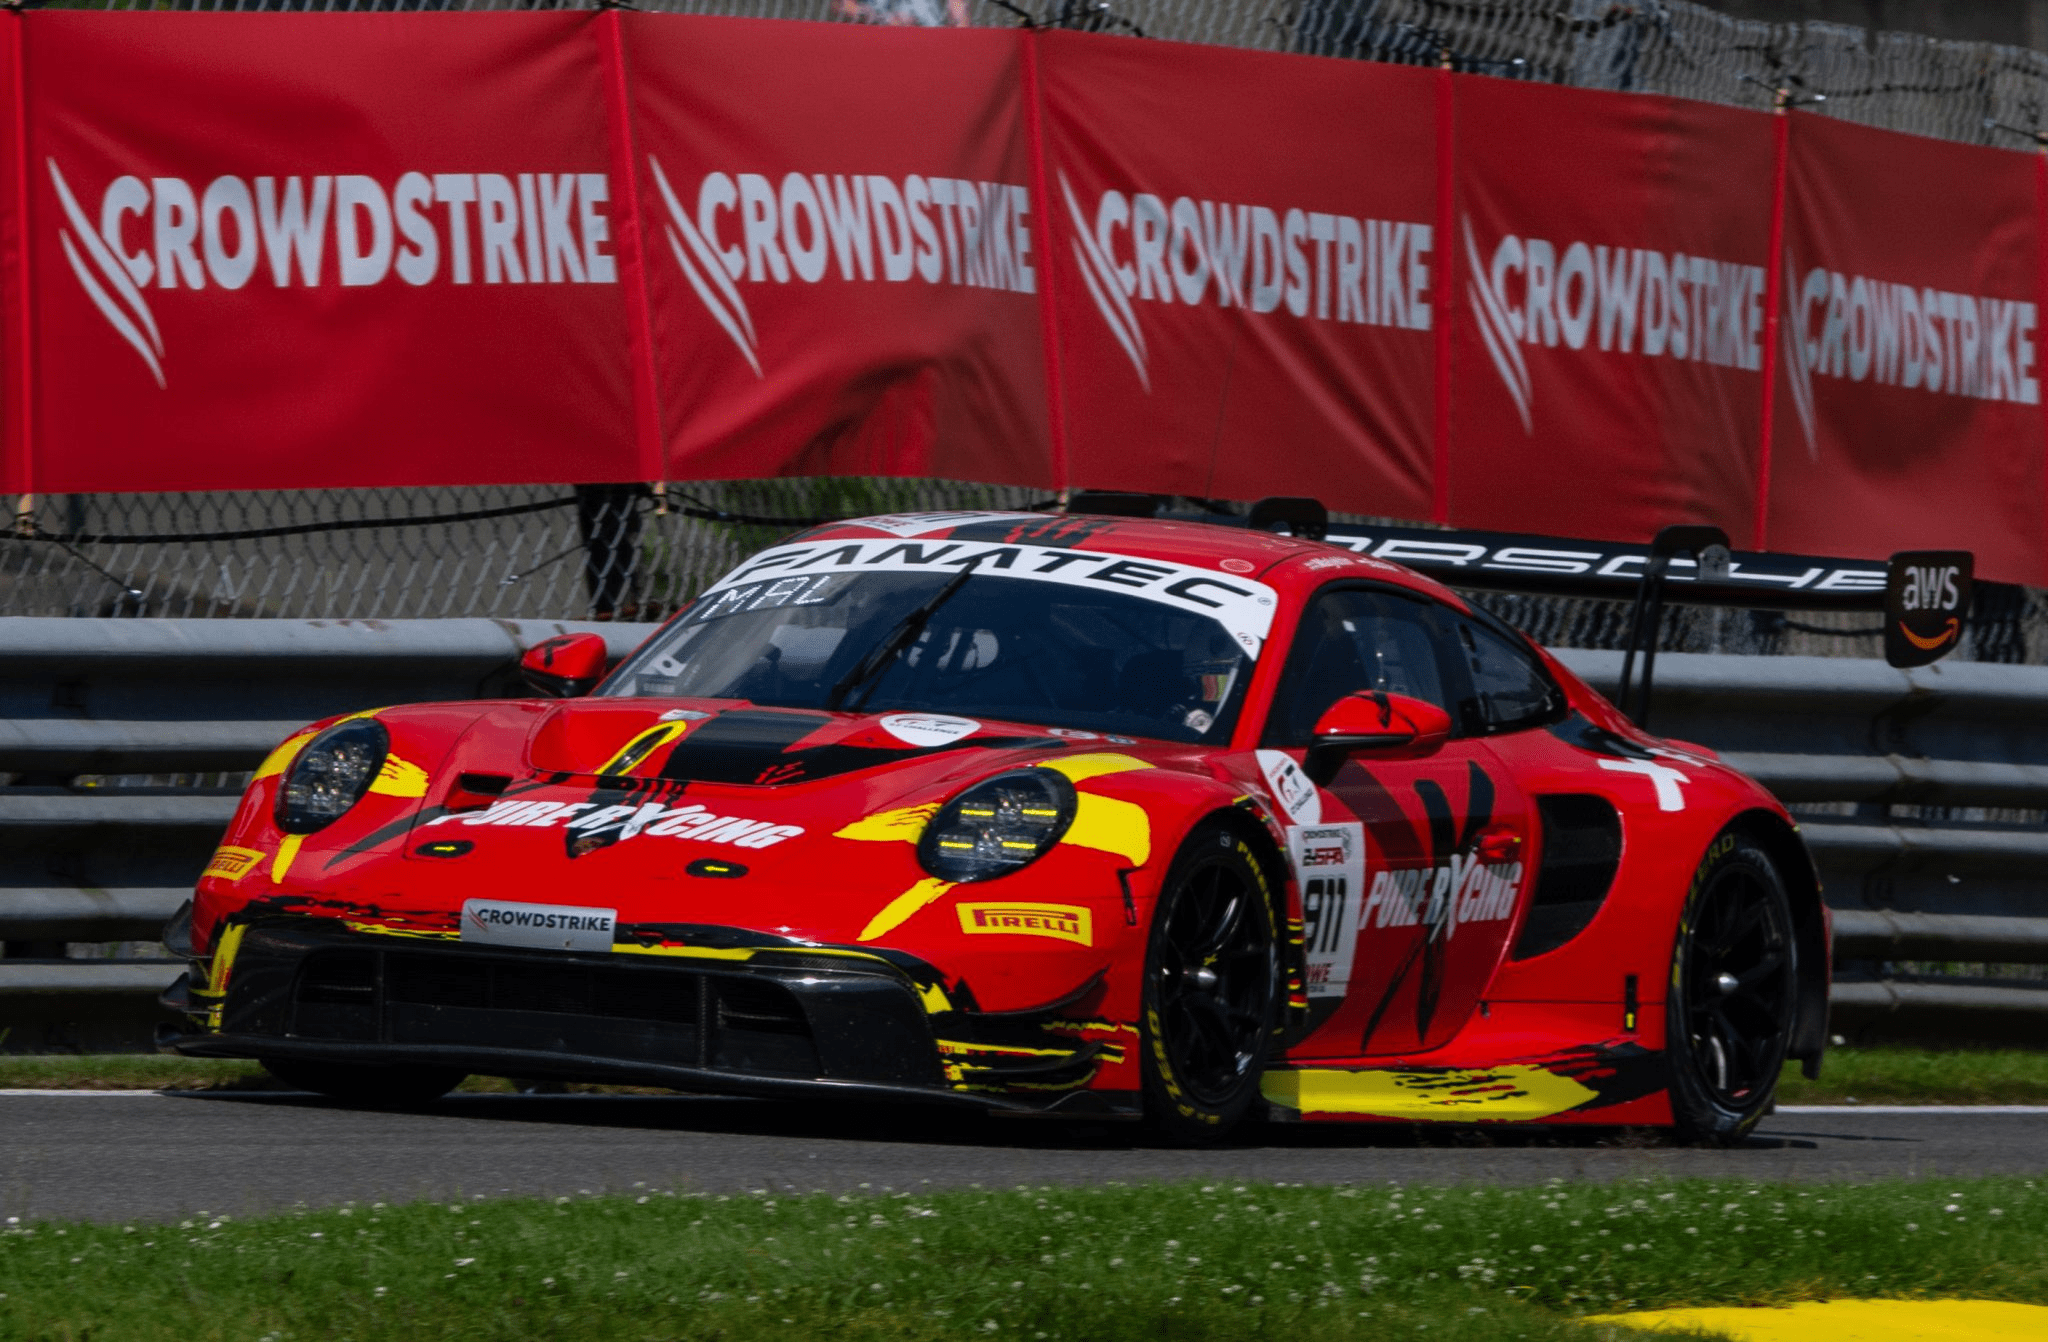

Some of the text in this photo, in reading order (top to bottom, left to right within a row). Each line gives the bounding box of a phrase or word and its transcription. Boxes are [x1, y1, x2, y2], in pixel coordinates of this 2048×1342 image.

[103, 171, 617, 290] CROWDSTRIKE
[699, 172, 1037, 294] CROWDSTRIKE
[1095, 189, 1433, 331] CROWDSTRIKE
[1491, 234, 1766, 372] CROWDSTRIKE
[1802, 267, 2041, 405] CROWDSTRIKE
[726, 543, 1256, 609] FANATEC
[1276, 531, 1888, 590] RSCHE
[1902, 566, 1959, 611] aws
[700, 575, 831, 619] MAL
[477, 908, 611, 933] CROWDSTRIKE
[972, 908, 1079, 935] PIRELLI
[1303, 877, 1347, 953] 911
[1358, 866, 1434, 931] PURE
